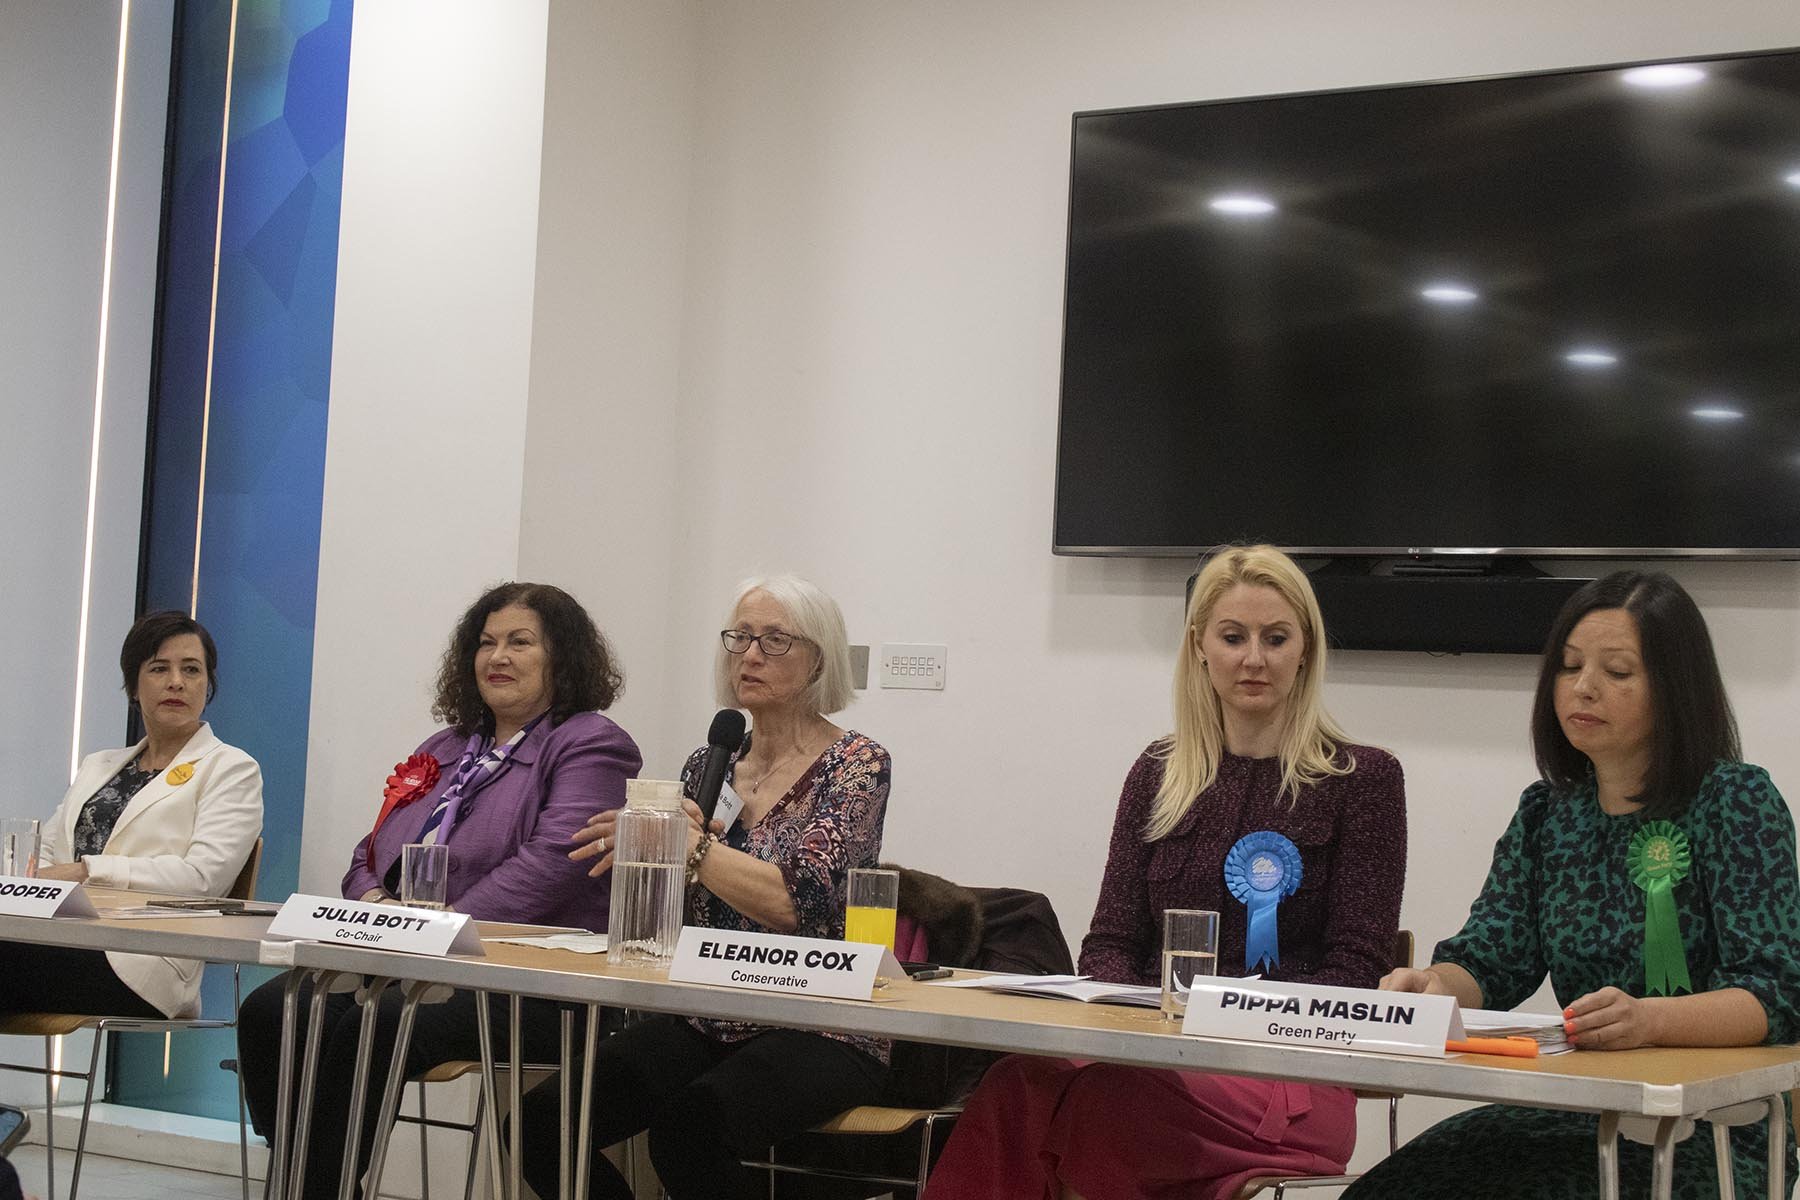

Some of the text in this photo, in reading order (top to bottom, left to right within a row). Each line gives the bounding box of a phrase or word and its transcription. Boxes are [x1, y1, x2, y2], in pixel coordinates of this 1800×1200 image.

[0, 883, 62, 899] OOPER
[312, 906, 431, 932] JULIA BOTT
[335, 928, 382, 943] Co-Chair
[698, 941, 858, 972] ELEANOR COX
[731, 969, 808, 988] Conservative
[1220, 991, 1415, 1025] PIPPA MASLIN
[1267, 1022, 1356, 1046] Green Party
